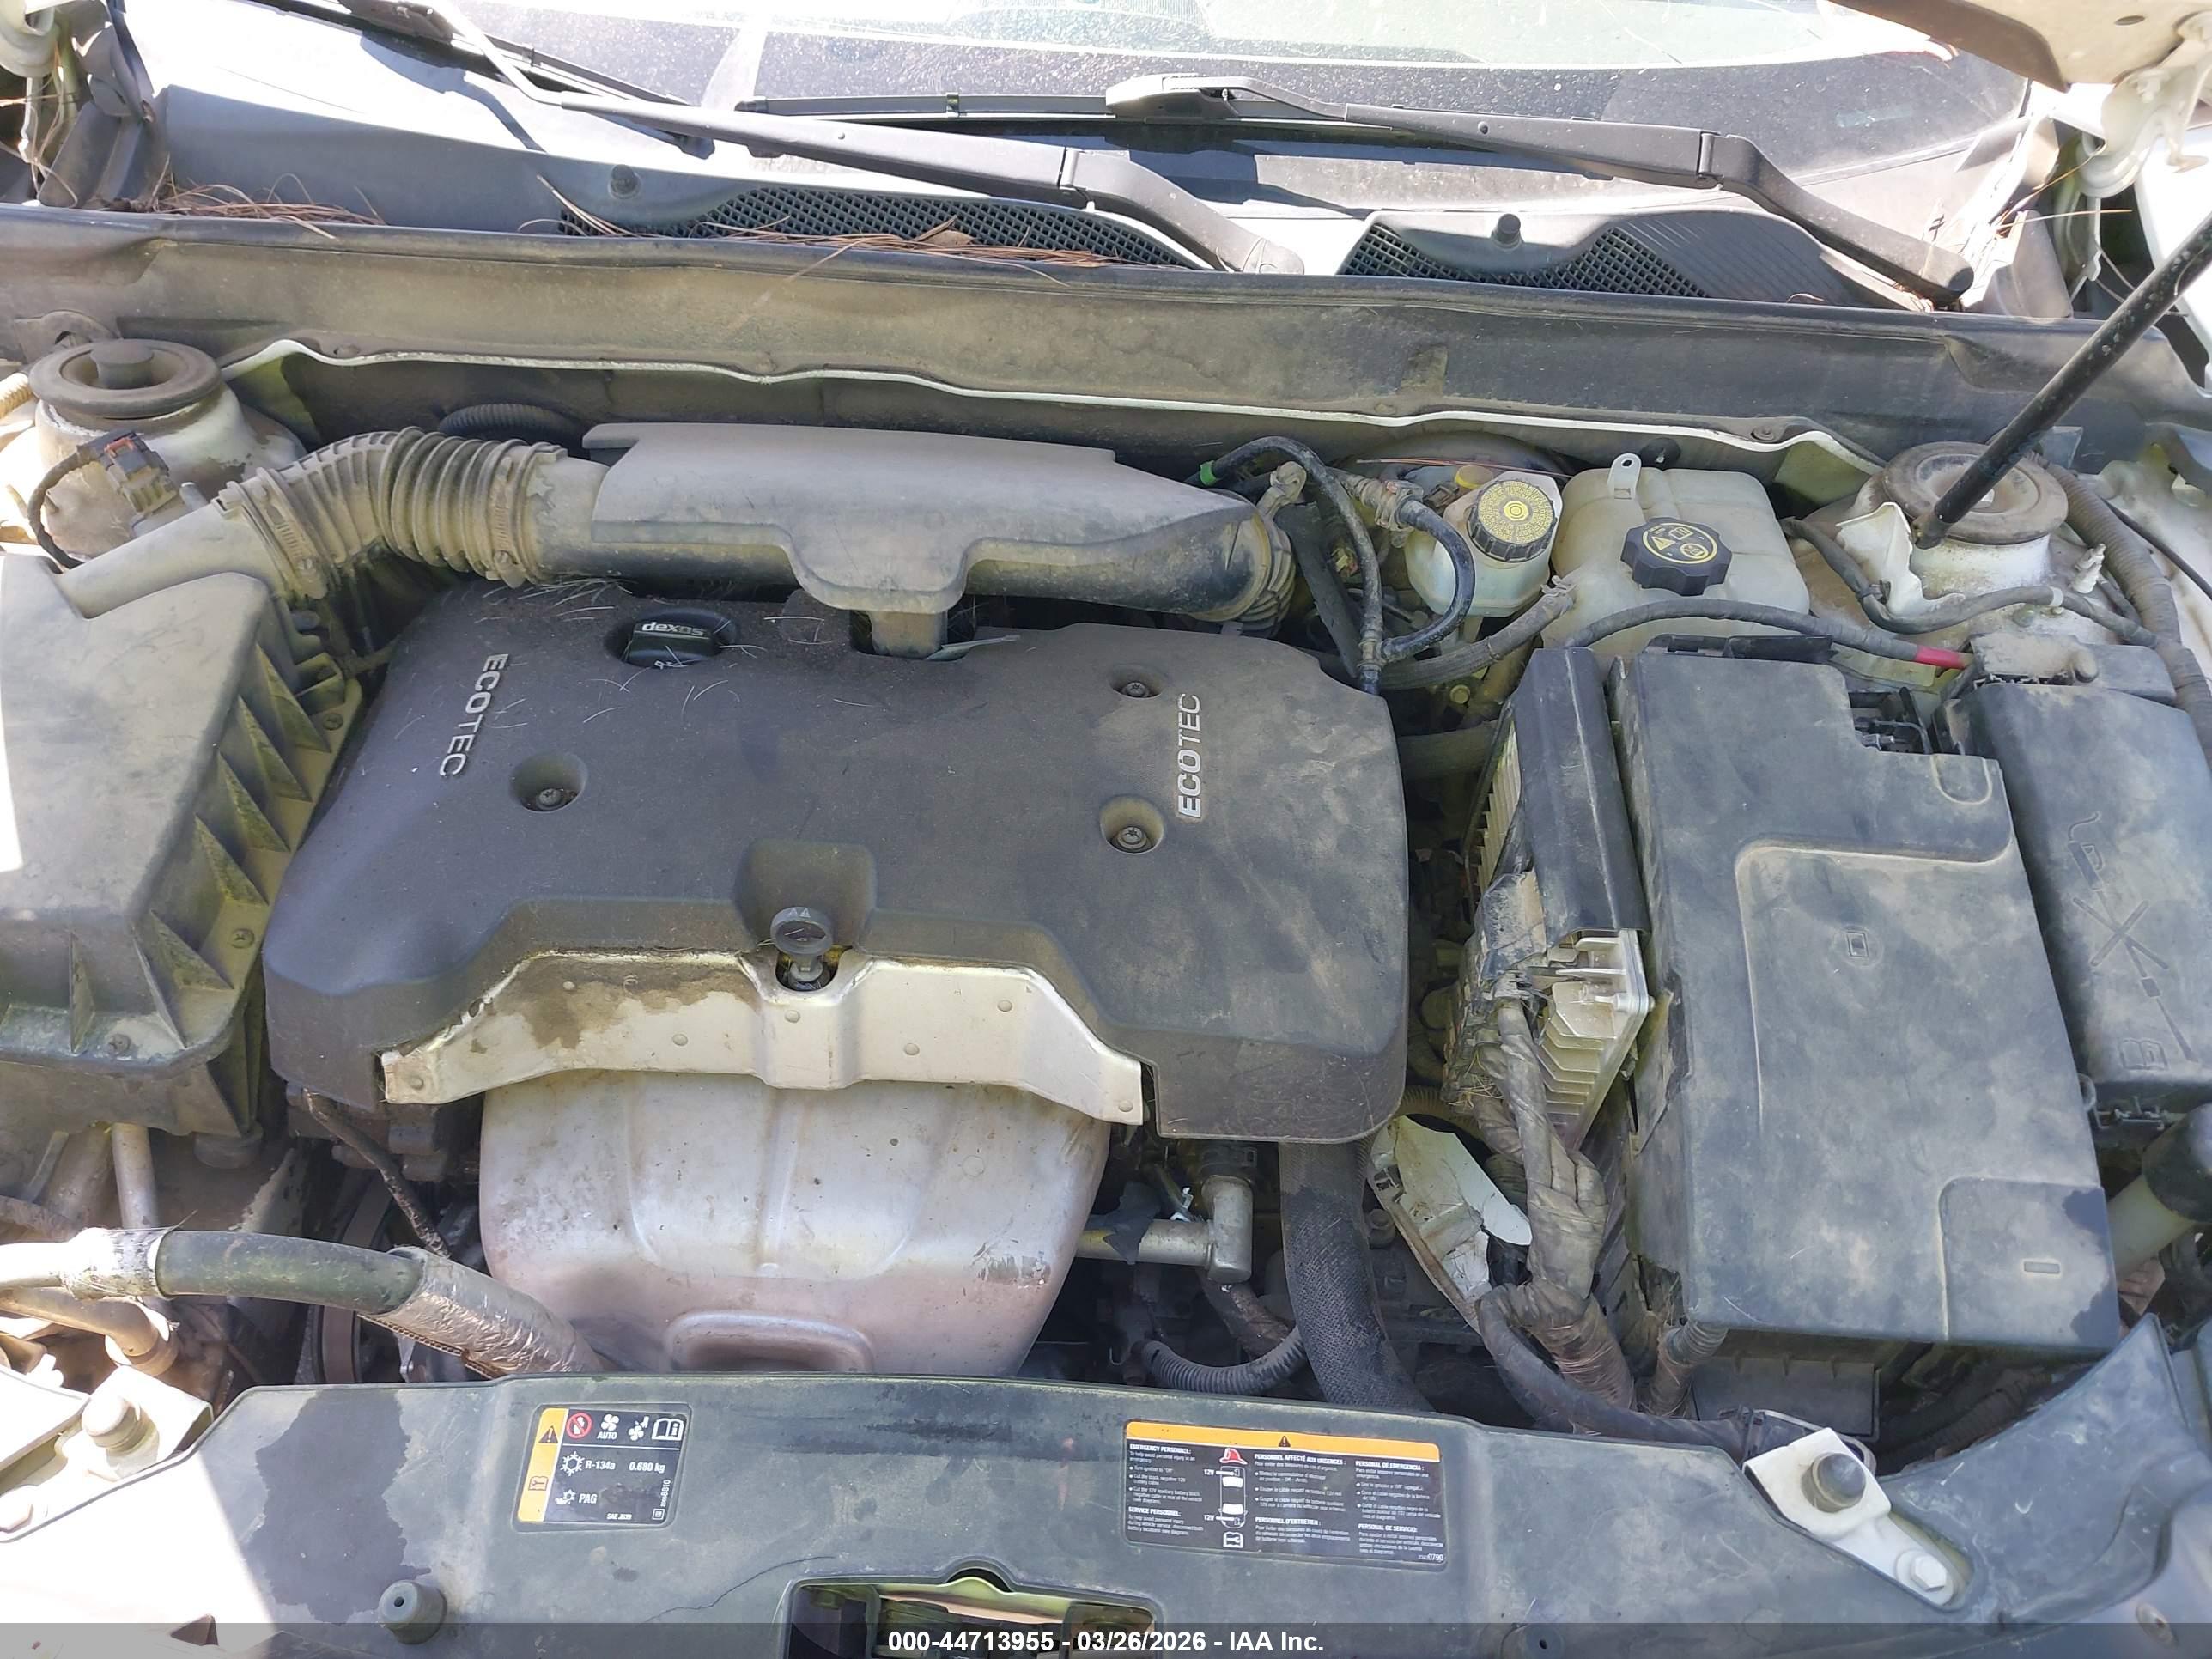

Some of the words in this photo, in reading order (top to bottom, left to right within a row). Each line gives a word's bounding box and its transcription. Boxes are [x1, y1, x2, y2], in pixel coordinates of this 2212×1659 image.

[641, 621, 706, 637] dexos
[439, 653, 510, 777] ECOTEC
[1177, 694, 1201, 818] ECOTEC
[596, 1431, 617, 1440] AUTO
[585, 1460, 616, 1471] R-134a
[629, 1462, 653, 1472] 0.680
[654, 1462, 665, 1474] kg
[578, 1493, 598, 1504] PAG
